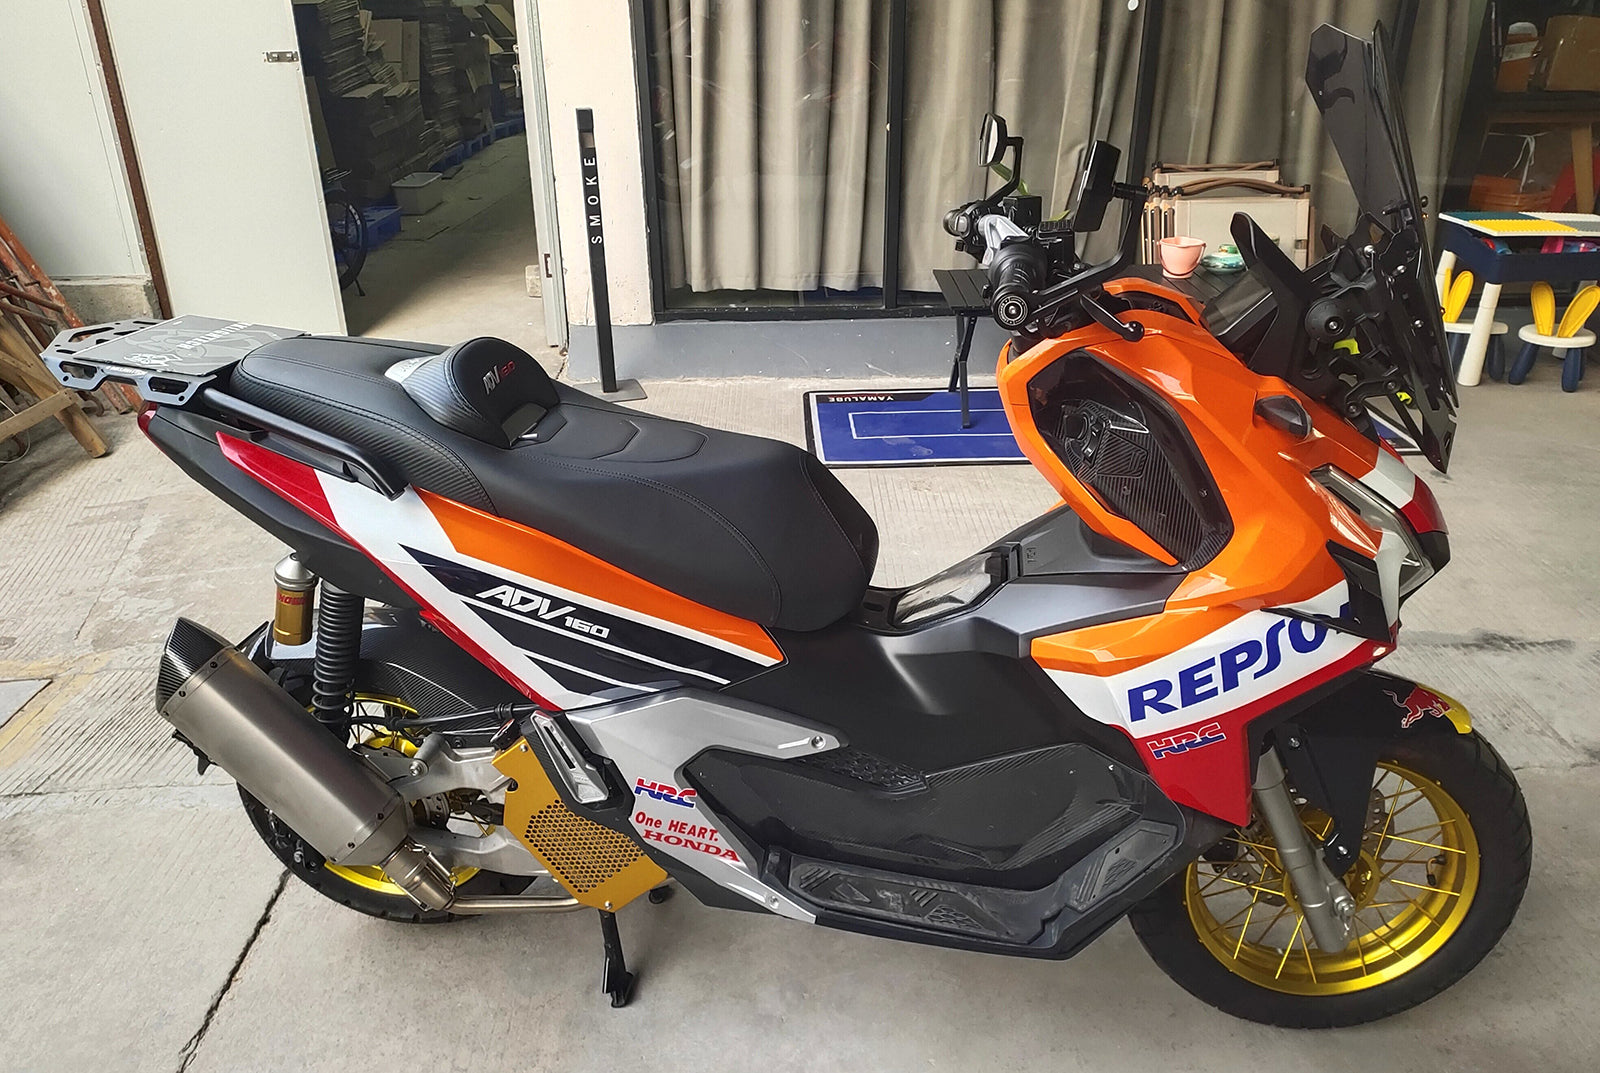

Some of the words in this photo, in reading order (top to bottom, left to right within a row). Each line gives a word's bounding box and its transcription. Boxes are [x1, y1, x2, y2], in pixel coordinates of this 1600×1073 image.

[583, 156, 603, 244] SMOKE
[828, 394, 894, 403] YAMALUBE
[475, 584, 577, 620] ADV
[1127, 602, 1349, 723] REPSO
[1147, 722, 1227, 760] HRC
[634, 777, 697, 808] HRC
[635, 811, 662, 829] One
[643, 829, 741, 862] HONDA
